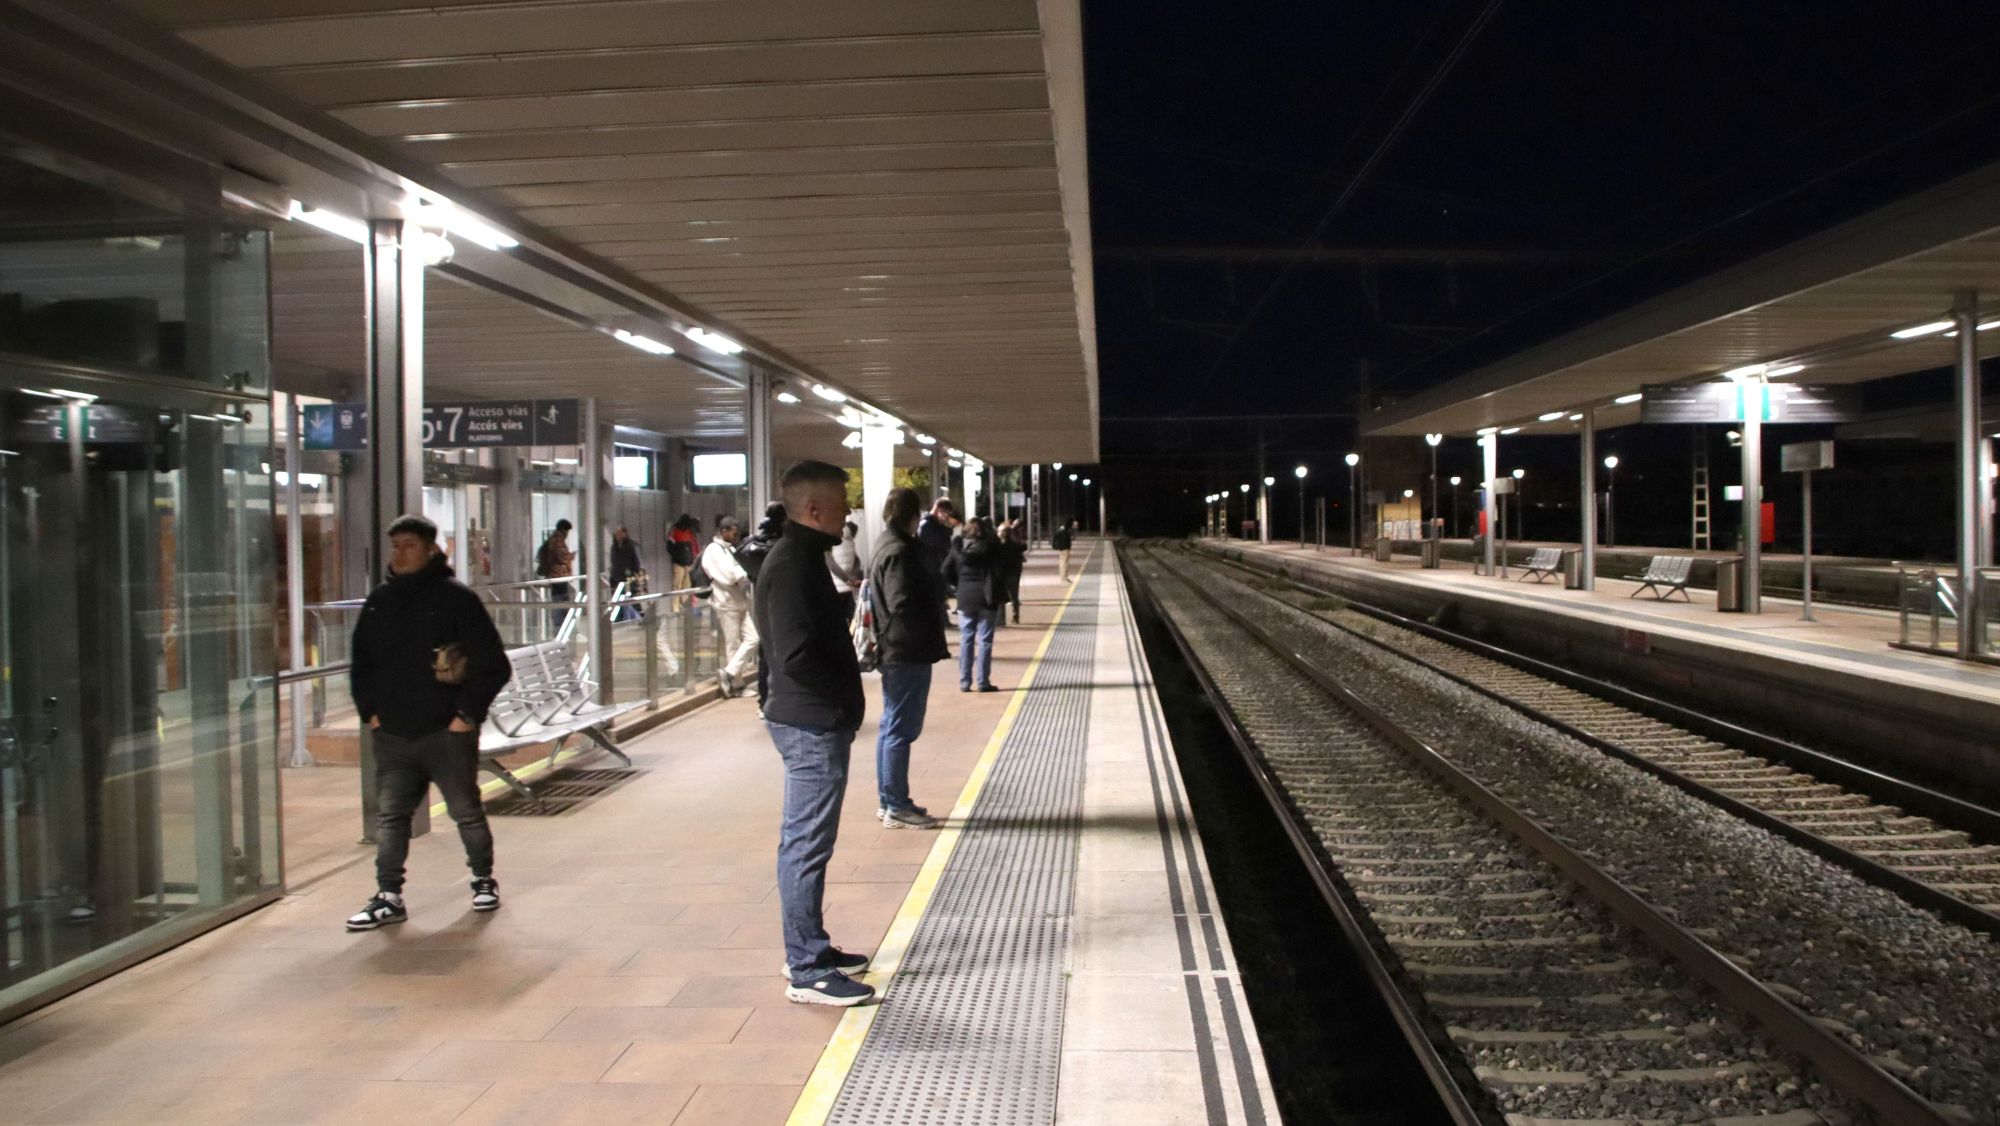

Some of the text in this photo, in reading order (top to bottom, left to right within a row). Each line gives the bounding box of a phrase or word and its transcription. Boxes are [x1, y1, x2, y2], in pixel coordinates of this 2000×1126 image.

[468, 405, 529, 417] Acceso vías
[468, 420, 524, 431] Accés vies
